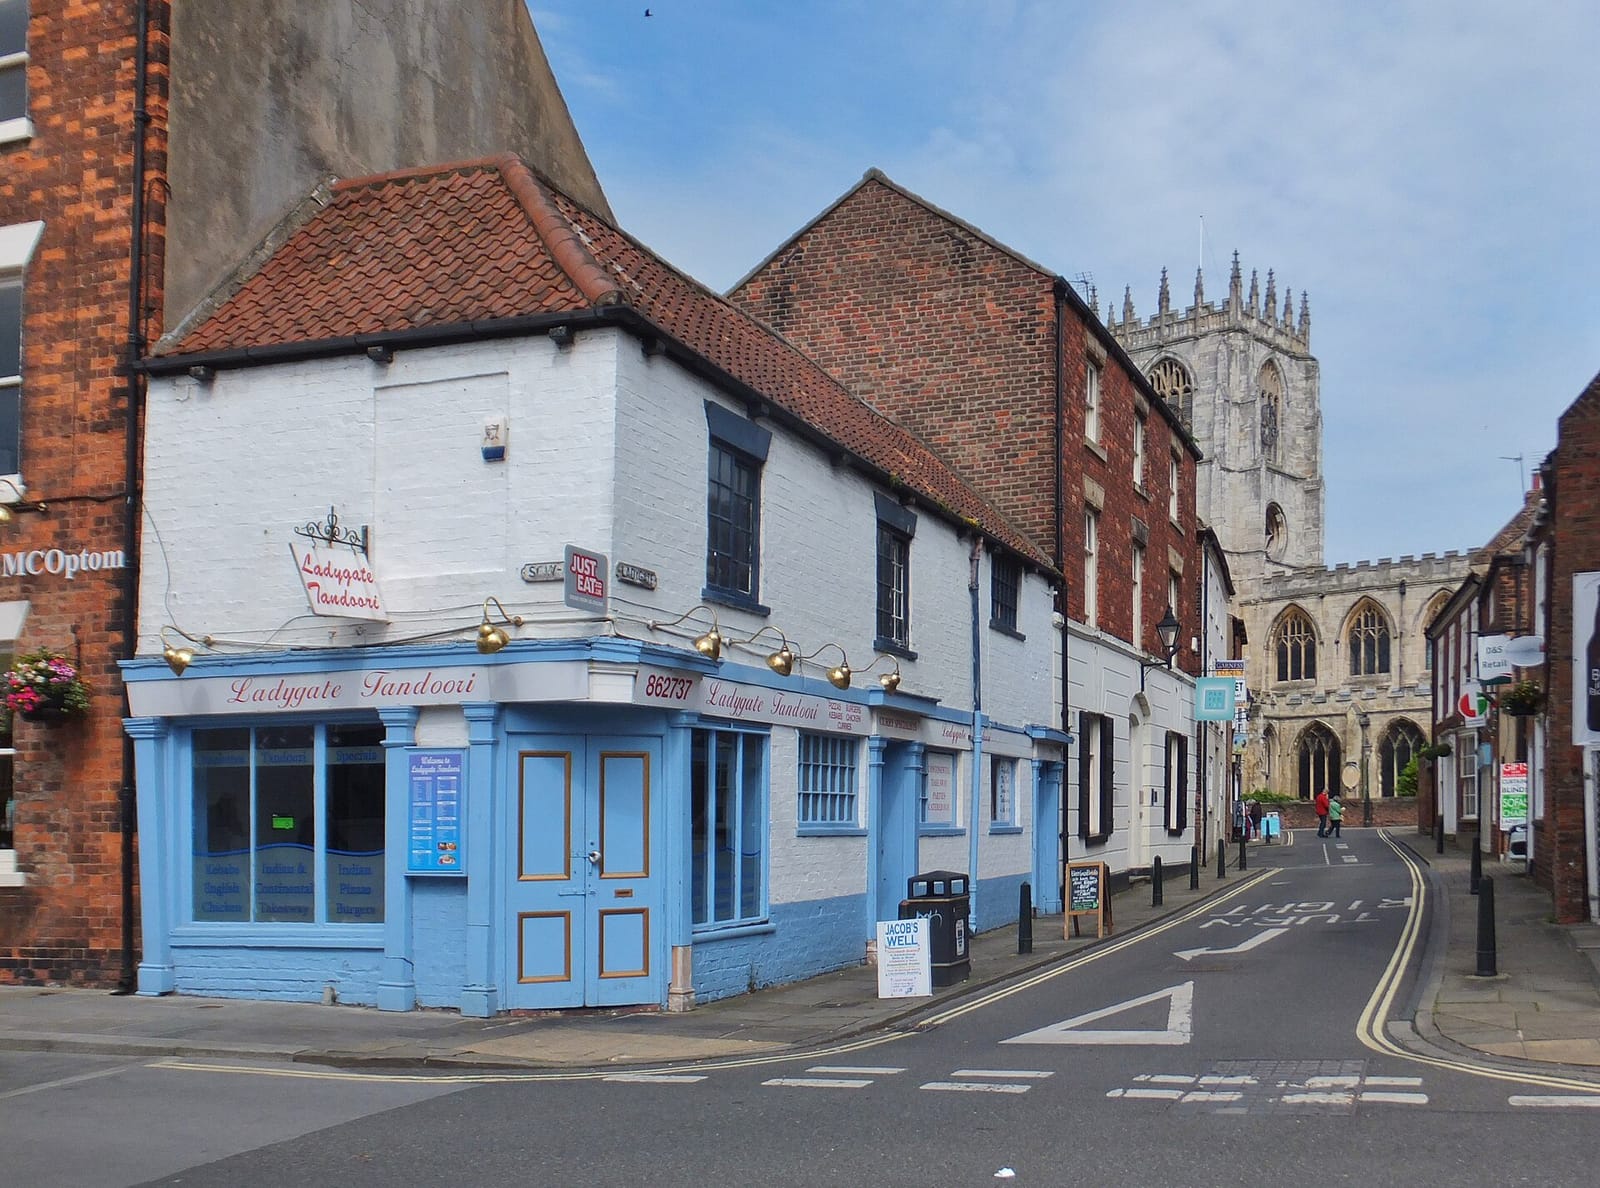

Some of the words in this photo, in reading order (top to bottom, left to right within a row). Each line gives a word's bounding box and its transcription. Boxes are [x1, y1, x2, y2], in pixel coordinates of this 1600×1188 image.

[1, 548, 126, 580] MCOptom
[301, 553, 374, 584] Ladygate
[571, 554, 597, 577] JUST
[306, 581, 380, 610] Tandoori
[577, 575, 596, 594] EAT
[1481, 659, 1508, 669] Retail
[226, 676, 343, 708] Ladygate
[360, 671, 477, 697] Tandoori
[645, 673, 694, 701] 862737
[705, 681, 764, 718] Ladygate
[770, 691, 820, 721] Tandoori
[885, 922, 919, 936] JACOB'S
[886, 934, 918, 947] WELL
